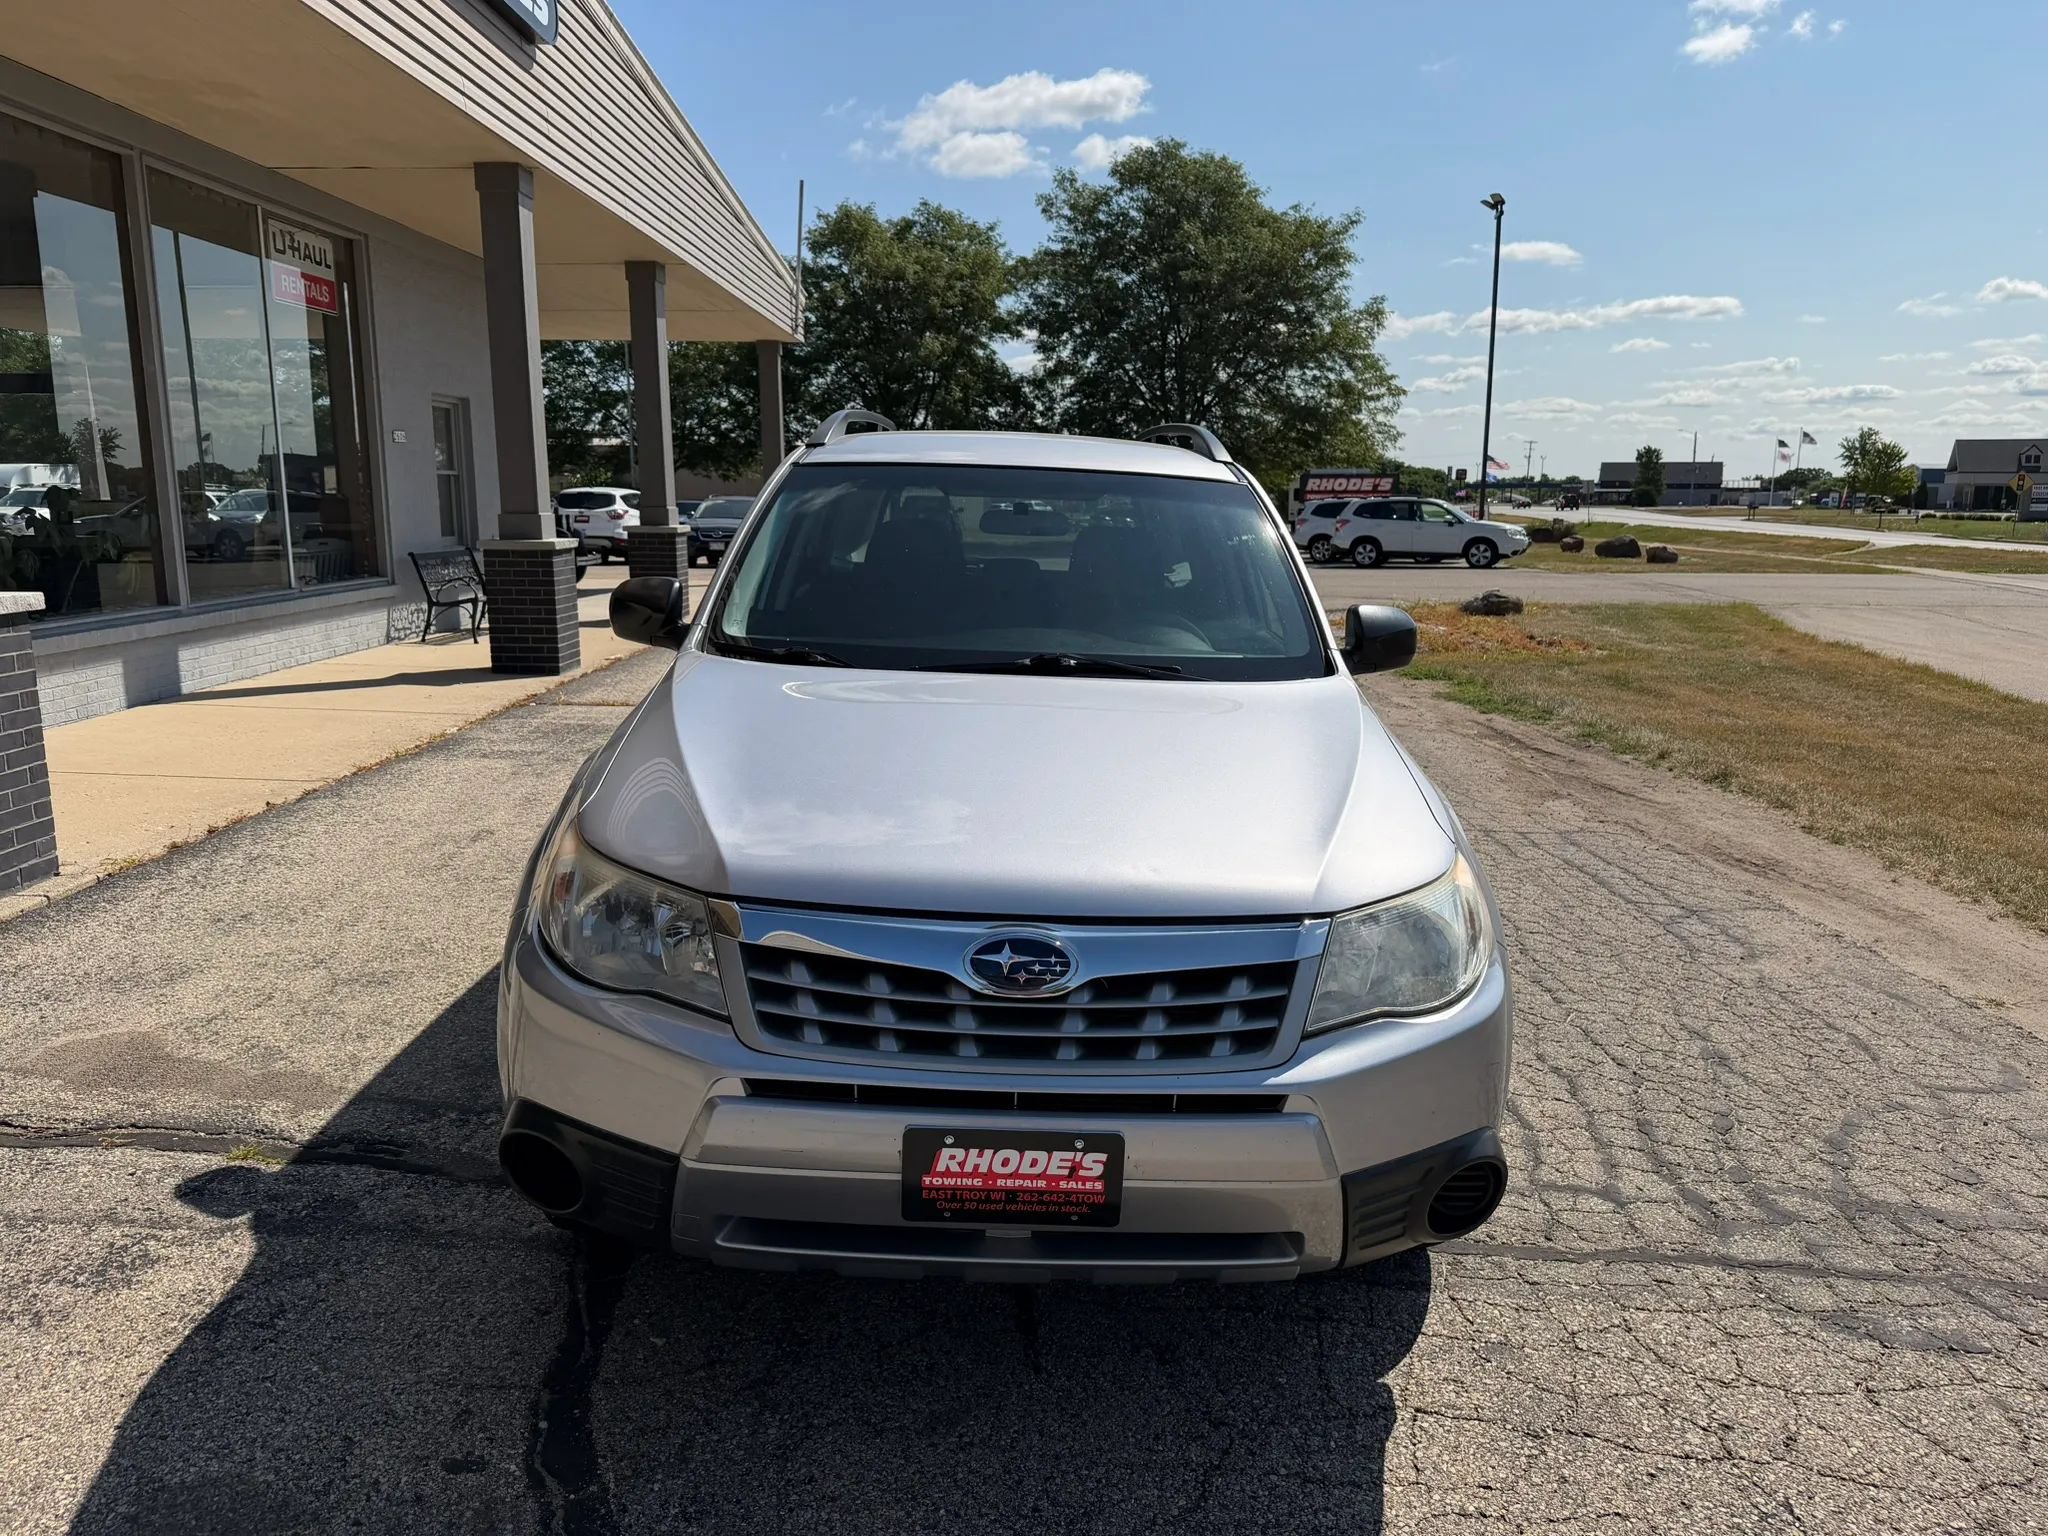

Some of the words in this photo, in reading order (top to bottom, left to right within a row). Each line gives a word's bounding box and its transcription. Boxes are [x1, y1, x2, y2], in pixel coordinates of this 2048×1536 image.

[281, 274, 330, 303] RENTALS
[1305, 478, 1393, 491] RHODE'S
[935, 1147, 1109, 1177] RHODE'S
[922, 1177, 983, 1186] TOWING
[996, 1179, 1047, 1188] REPAIR
[1059, 1180, 1103, 1190] SALES
[922, 1190, 953, 1199] EAST
[954, 1190, 987, 1200] TROY
[990, 1191, 1006, 1201] WI
[1016, 1192, 1106, 1204] 262-642-4TOW
[936, 1201, 961, 1209] Over
[963, 1202, 977, 1210] 50
[978, 1202, 1004, 1211] used
[1005, 1202, 1047, 1212] vehicles
[1048, 1204, 1059, 1212] in
[1061, 1204, 1092, 1213] stock.
